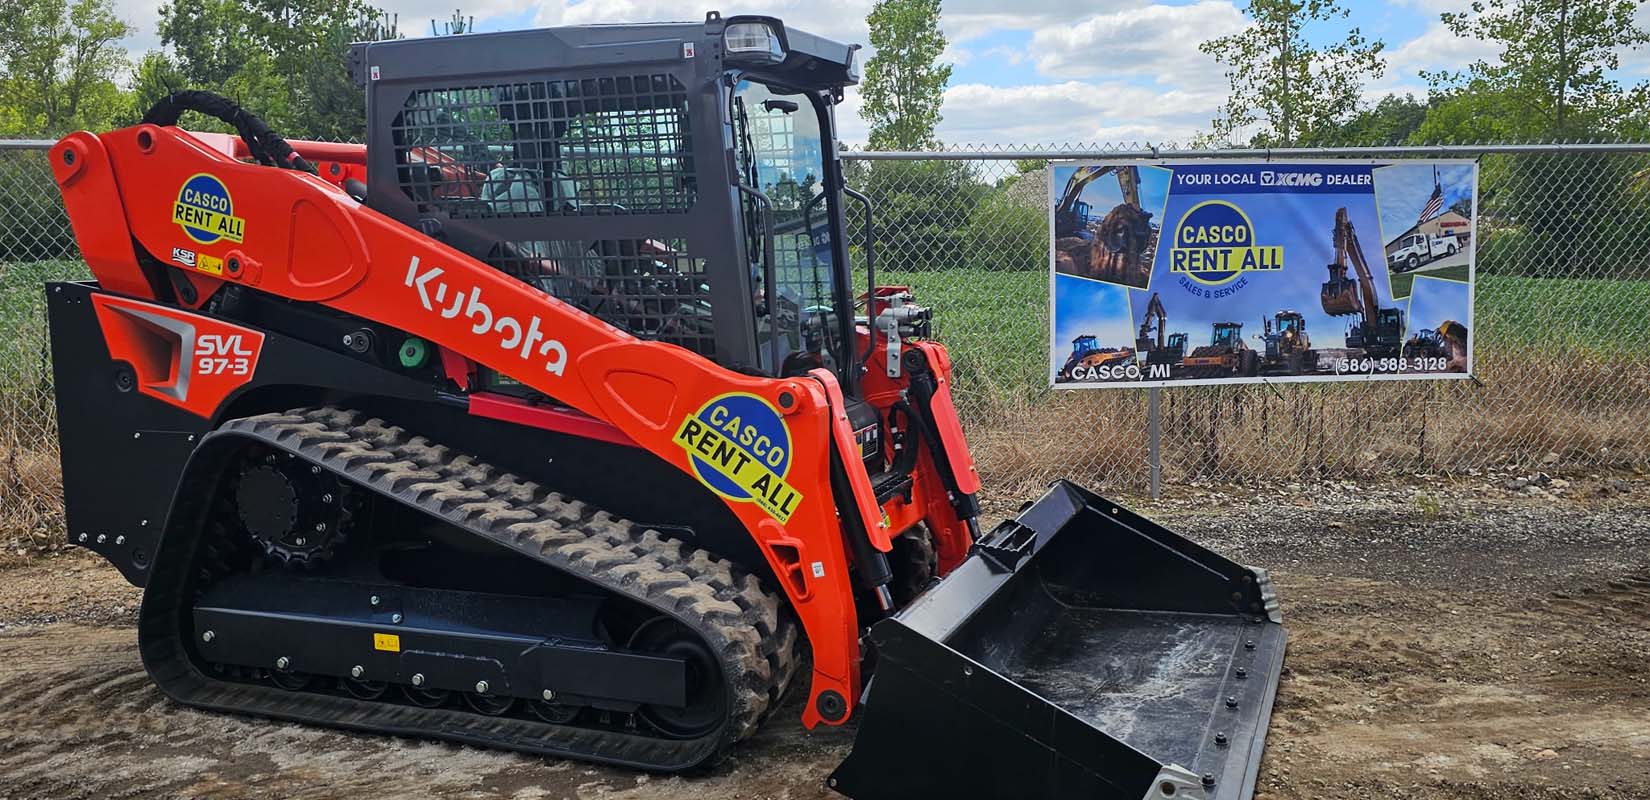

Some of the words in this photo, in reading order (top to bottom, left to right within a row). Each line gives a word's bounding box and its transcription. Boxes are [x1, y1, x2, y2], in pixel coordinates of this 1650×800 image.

[1177, 174, 1212, 185] YOUR
[1215, 173, 1256, 185] LOCAL
[1273, 173, 1323, 187] XCMG
[1327, 174, 1371, 185] DEALER
[184, 189, 227, 212] CASCO
[175, 204, 213, 227] RENT
[218, 217, 242, 236] ALL
[1182, 225, 1247, 243] CASCO
[172, 247, 196, 261] KSR
[1173, 249, 1232, 272] RENT
[1241, 248, 1281, 270] ALL
[1179, 276, 1203, 297] SALES
[1204, 290, 1211, 298] &
[1214, 277, 1249, 299] SERVICE
[404, 255, 568, 377] Kubota
[195, 334, 252, 355] SVL
[198, 358, 249, 375] 97-3
[1071, 365, 1144, 381] CASCO,
[1149, 363, 1171, 378] MI
[1335, 357, 1374, 376] (586)
[1378, 357, 1447, 371] 588-3128
[710, 405, 784, 467] CASCO
[680, 419, 751, 475] RENT
[751, 473, 795, 516] ALL
